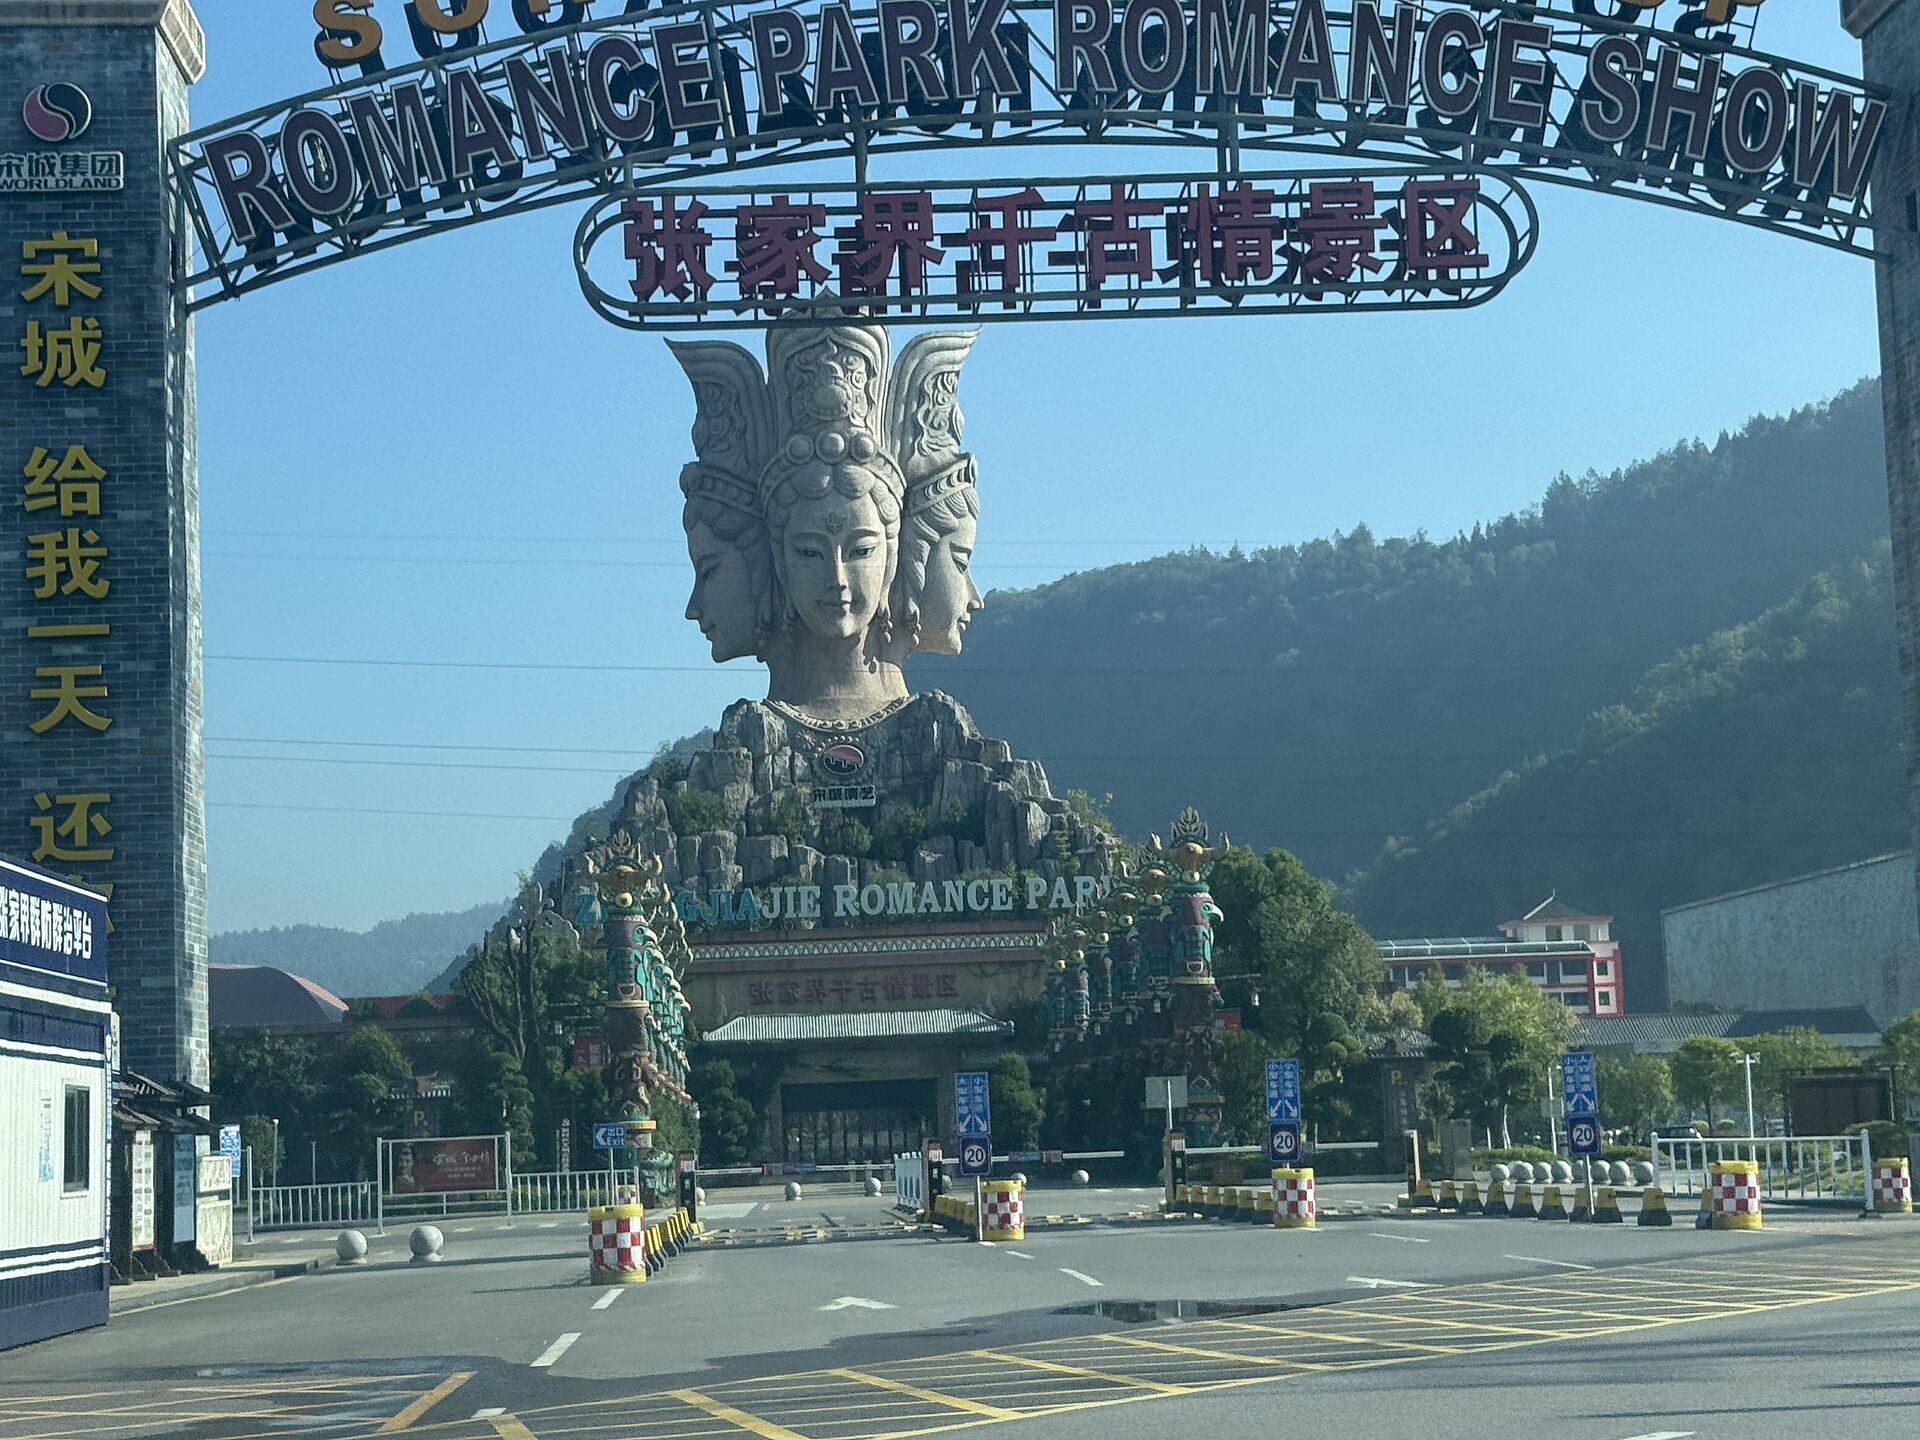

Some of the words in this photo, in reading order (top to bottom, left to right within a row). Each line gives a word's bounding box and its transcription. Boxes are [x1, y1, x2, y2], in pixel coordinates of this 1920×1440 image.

[201, 20, 724, 245] ROMANCE
[749, 0, 1022, 115] PARK
[1053, 0, 1552, 128] ROMANCE
[1580, 34, 1888, 199] SHOW
[0, 178, 121, 190] WORLDLAND
[623, 178, 1490, 298] 张家界千古情景区
[833, 880, 1013, 917] ROMANCE
[1026, 875, 1110, 911] PAR
[414, 1111, 424, 1125] P
[1275, 1135, 1293, 1149] 20
[1576, 1128, 1592, 1142] 20
[966, 1148, 984, 1163] 20
